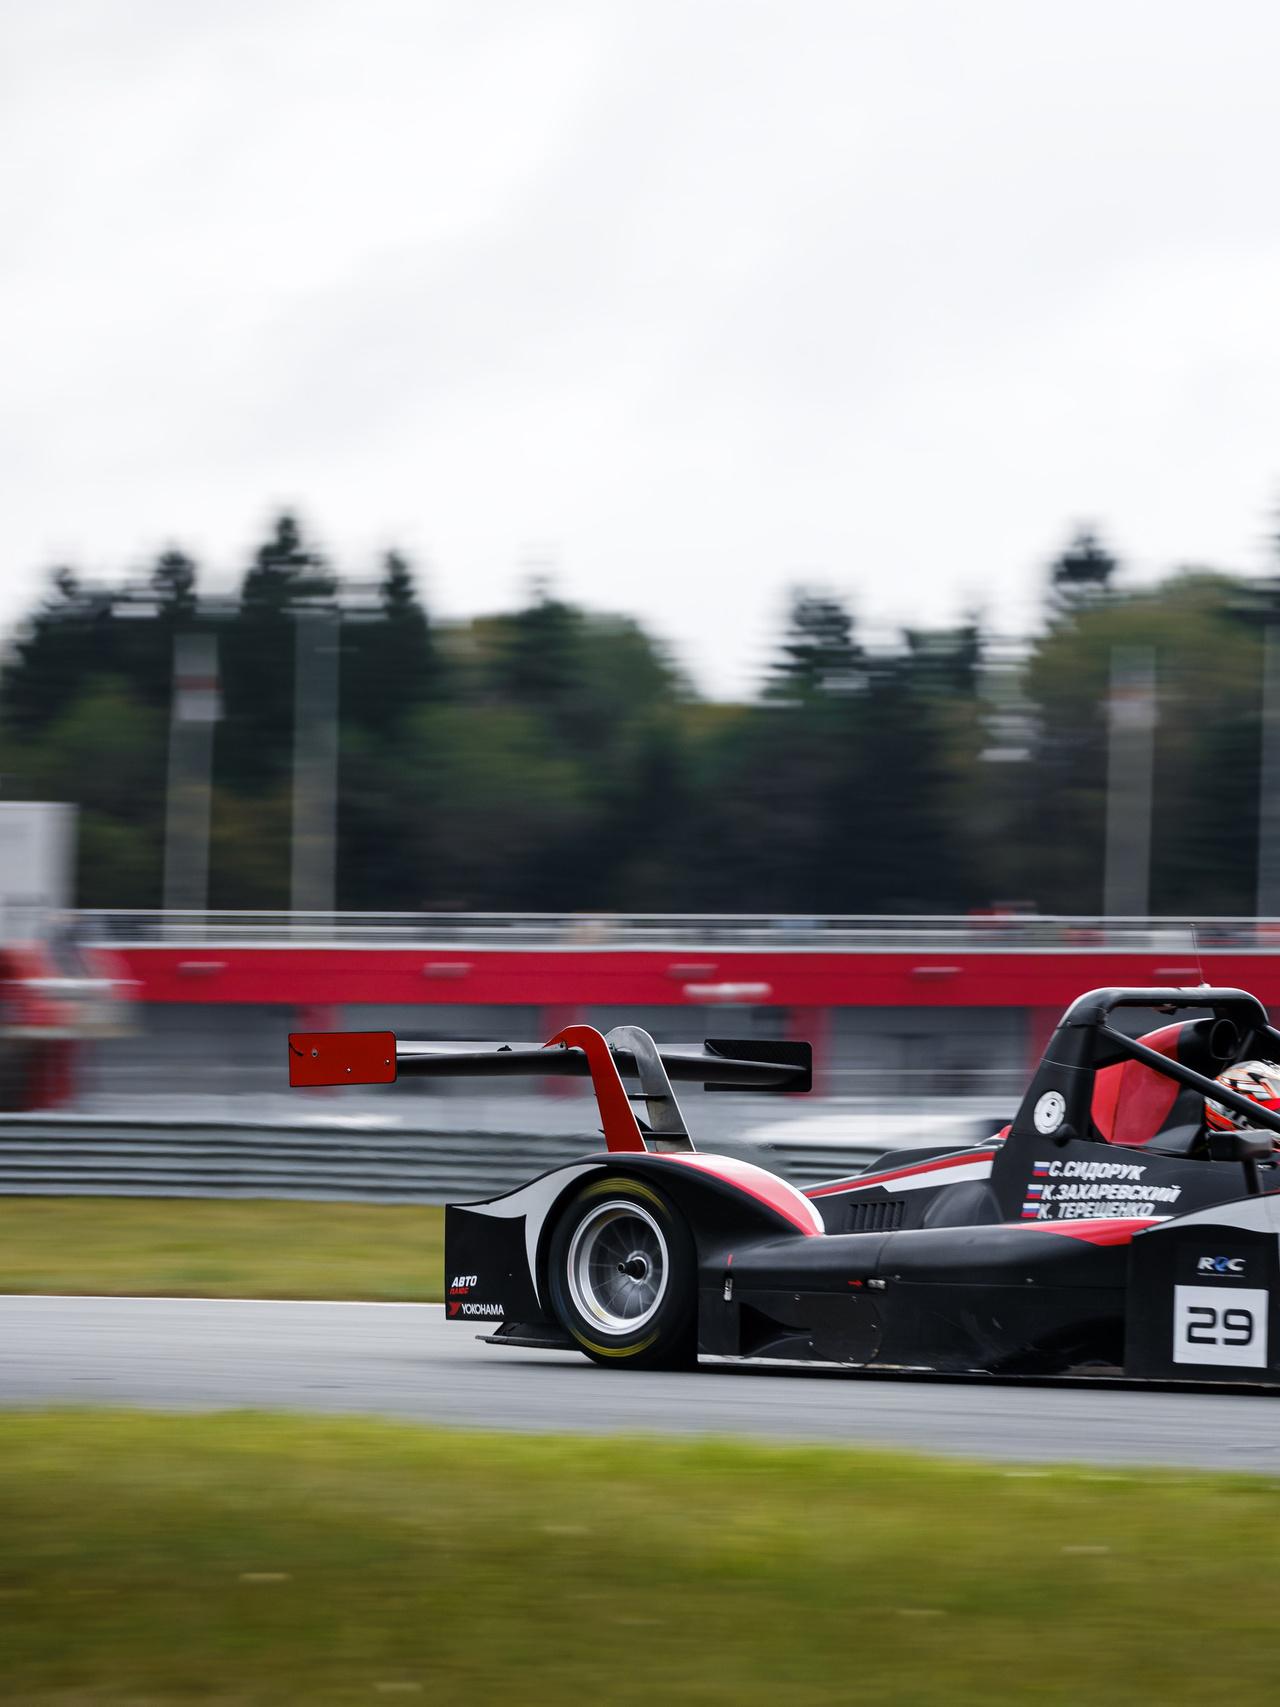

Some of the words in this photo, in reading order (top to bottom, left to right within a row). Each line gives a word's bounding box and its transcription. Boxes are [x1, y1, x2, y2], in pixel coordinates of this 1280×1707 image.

[1048, 1161, 1147, 1181] С.СИДОРУК
[1041, 1184, 1182, 1203] К.ЗАХАРЕВСКИЙ
[1058, 1202, 1156, 1218] ТЕРЕЩЕНКО
[451, 1275, 478, 1288] АВТО
[461, 1303, 505, 1316] YOKOHAMA
[1186, 1306, 1256, 1347] 29
